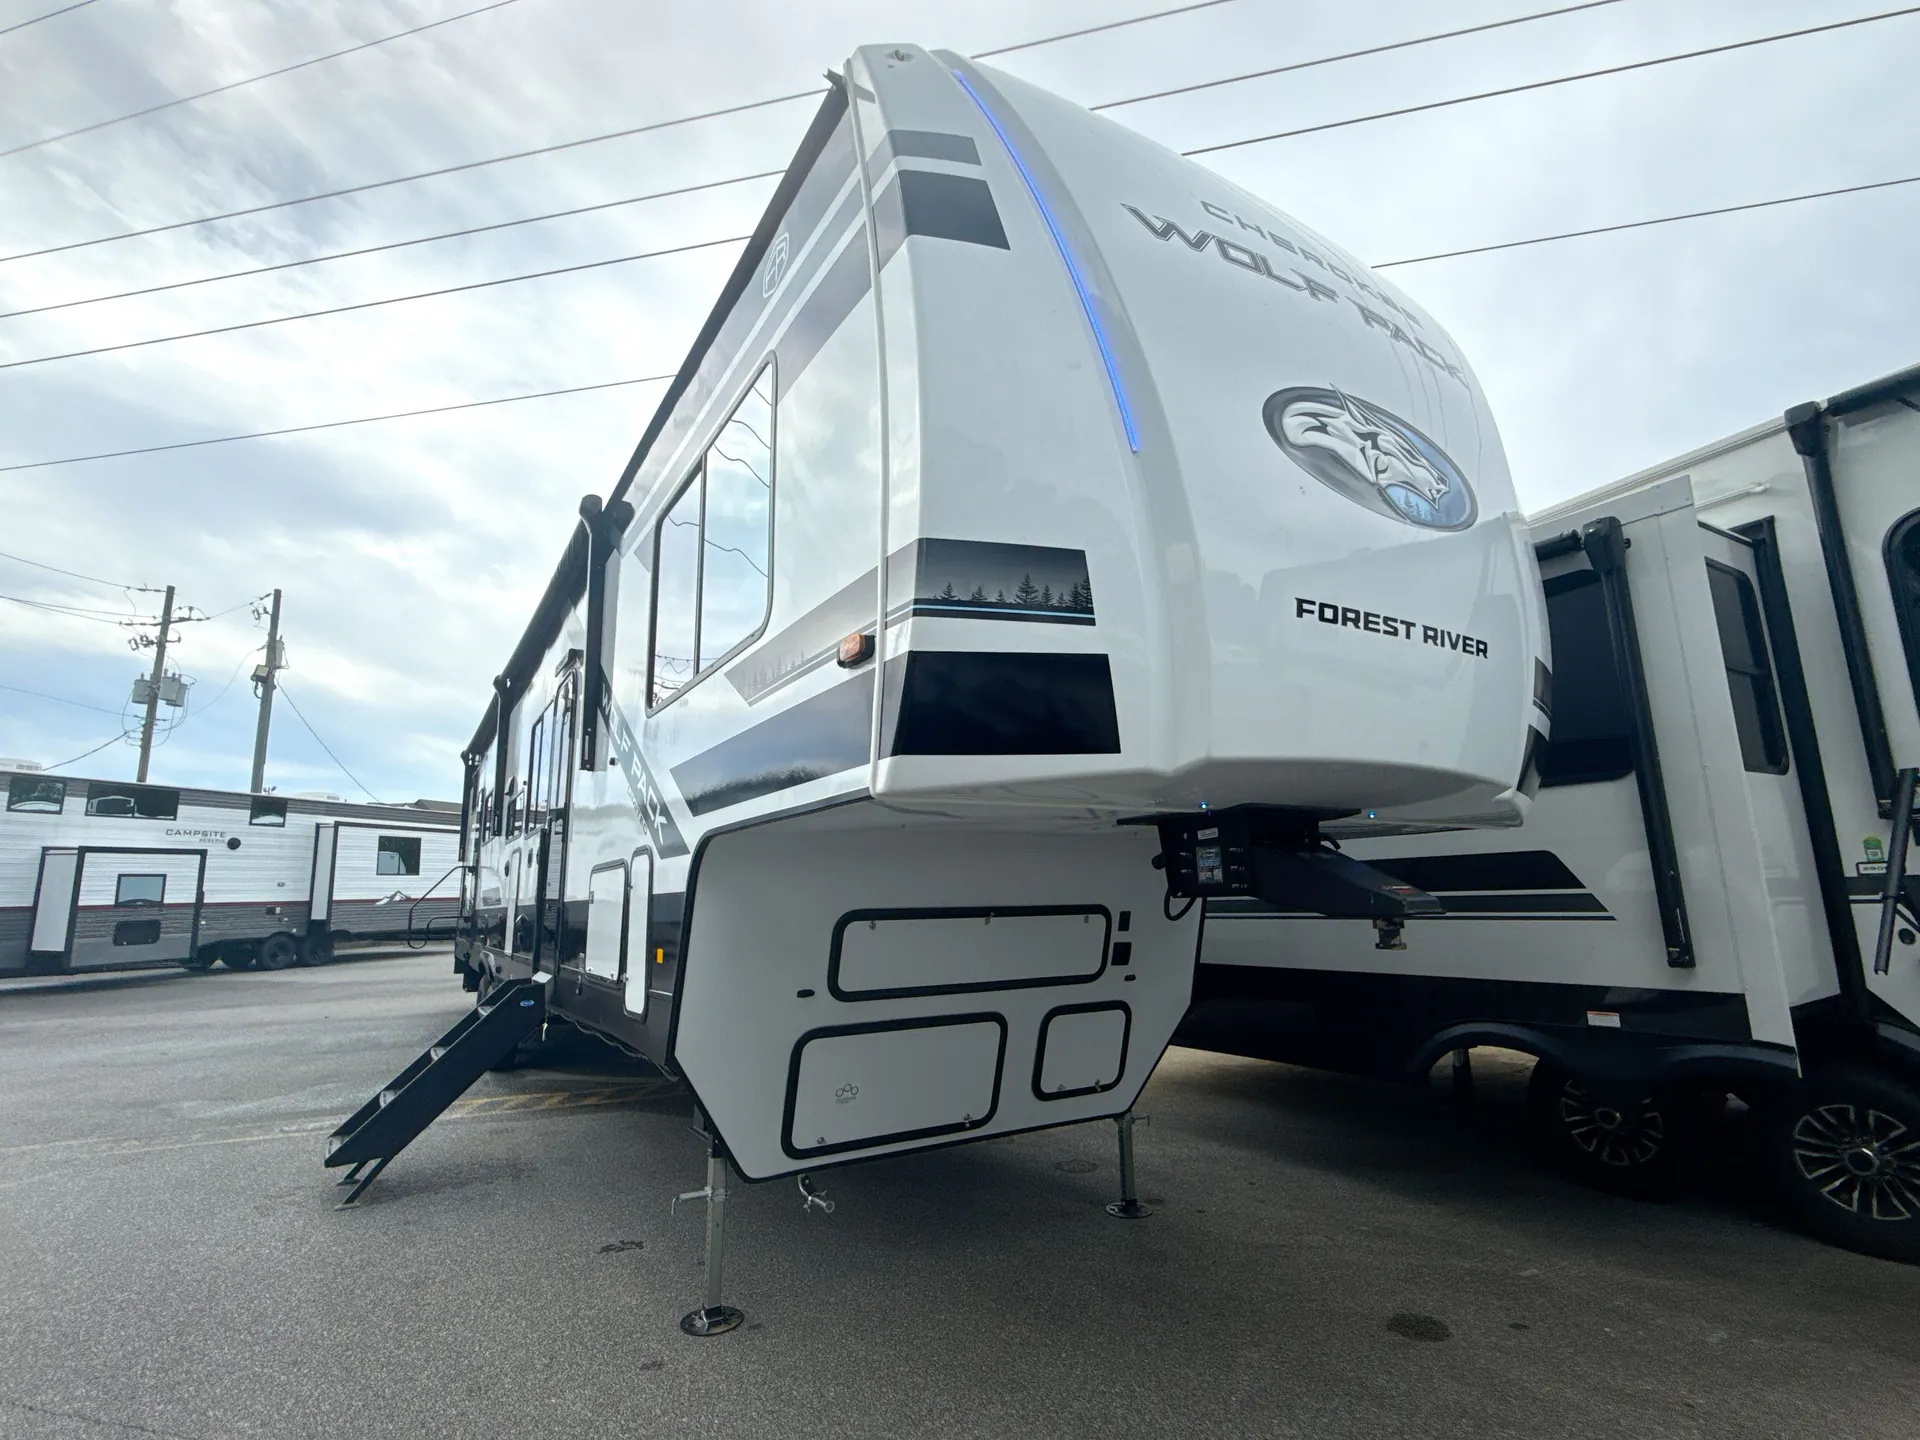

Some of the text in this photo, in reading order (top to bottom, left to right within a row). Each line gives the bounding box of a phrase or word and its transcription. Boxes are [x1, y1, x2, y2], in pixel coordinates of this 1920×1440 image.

[1119, 202, 1471, 391] WOLF PACK
[1200, 200, 1424, 330] CHEROKEE
[1294, 597, 1488, 659] FOREST RIVER
[602, 683, 668, 845] WOLF PACK
[165, 828, 227, 838] CAMPSITE
